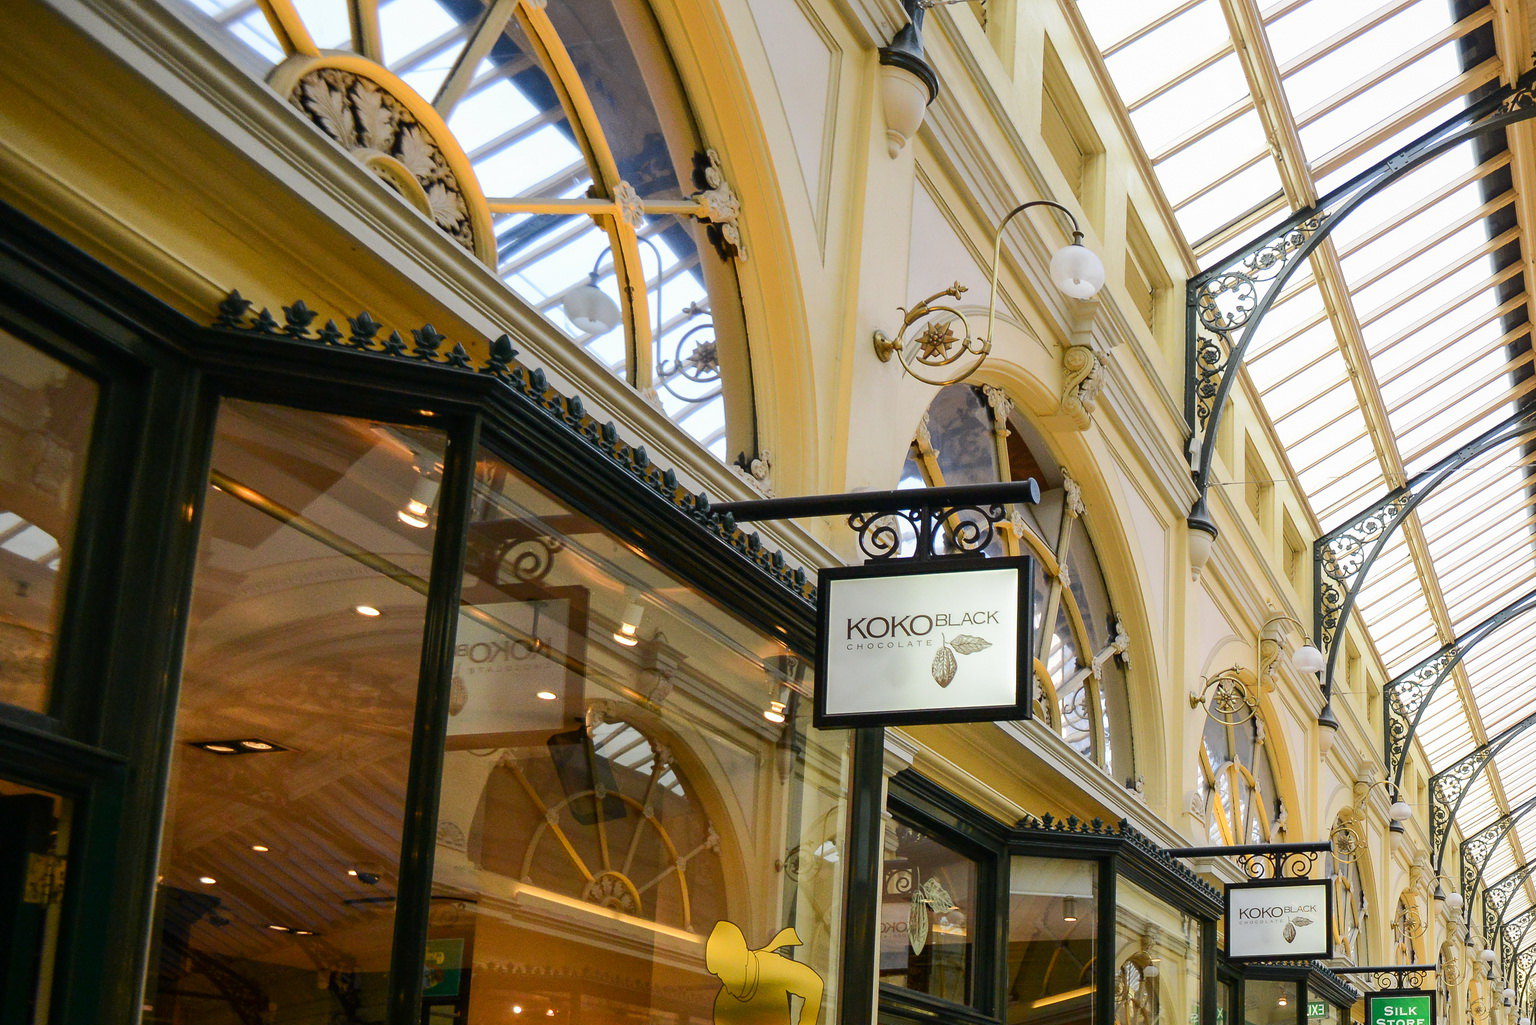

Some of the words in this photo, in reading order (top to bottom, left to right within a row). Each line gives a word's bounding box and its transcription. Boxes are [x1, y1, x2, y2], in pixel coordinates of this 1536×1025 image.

[846, 614, 934, 640] KOKO
[935, 610, 1000, 627] BLACK
[846, 639, 933, 651] CHOCOLATE
[1239, 906, 1284, 920] KOKO
[1283, 904, 1317, 914] BLACK
[1384, 1006, 1418, 1016] SILK
